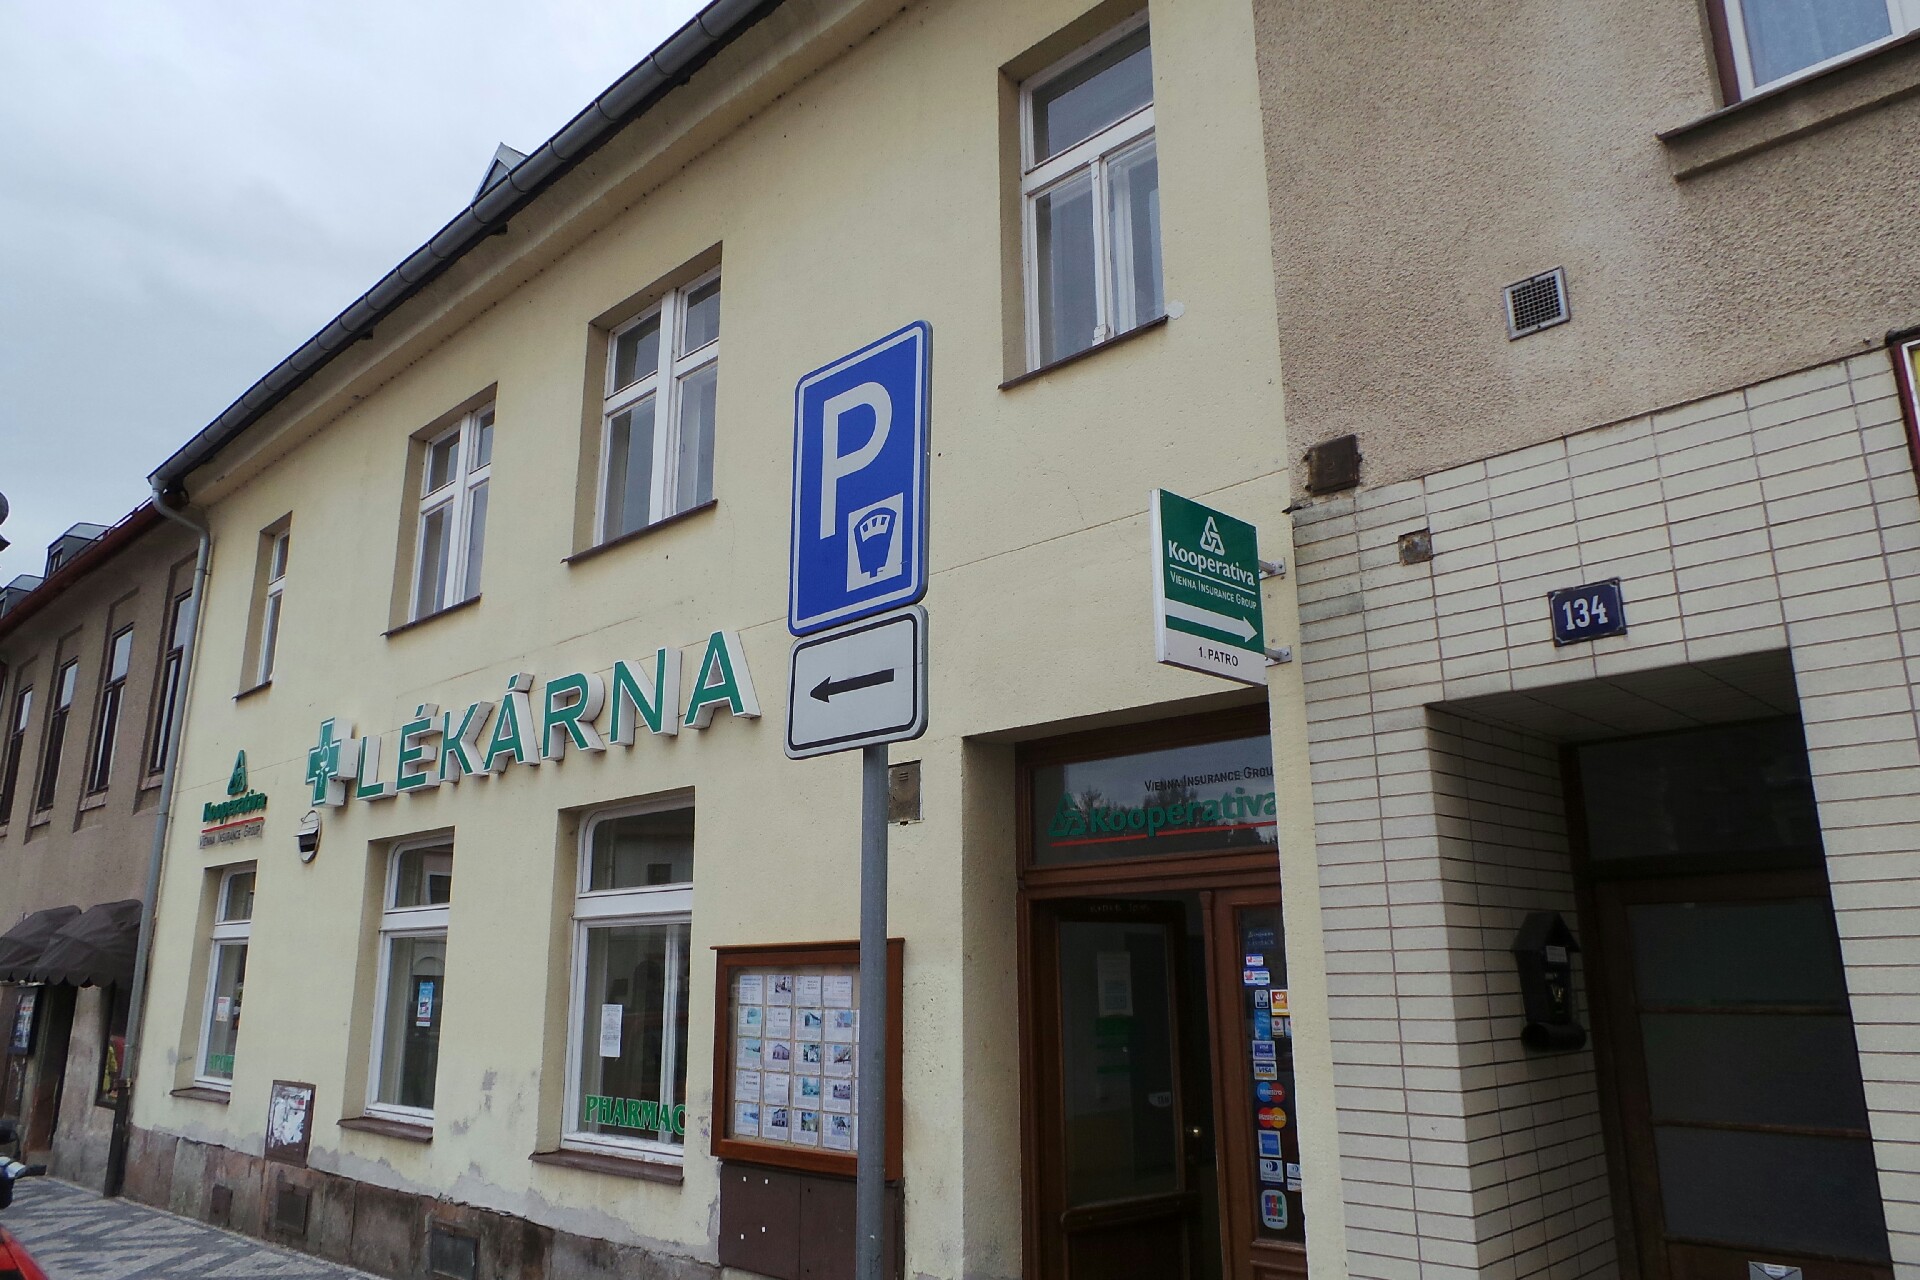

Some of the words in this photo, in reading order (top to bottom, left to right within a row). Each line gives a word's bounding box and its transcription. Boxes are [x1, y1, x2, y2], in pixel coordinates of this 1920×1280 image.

[820, 381, 893, 540] P
[1168, 539, 1256, 587] Kooperativa
[1562, 594, 1608, 631] 134
[1208, 648, 1239, 667] PATRO
[356, 629, 762, 801] LÉKÁRNA
[202, 788, 267, 825] Kooperativa
[1089, 786, 1277, 837] Kooperativa
